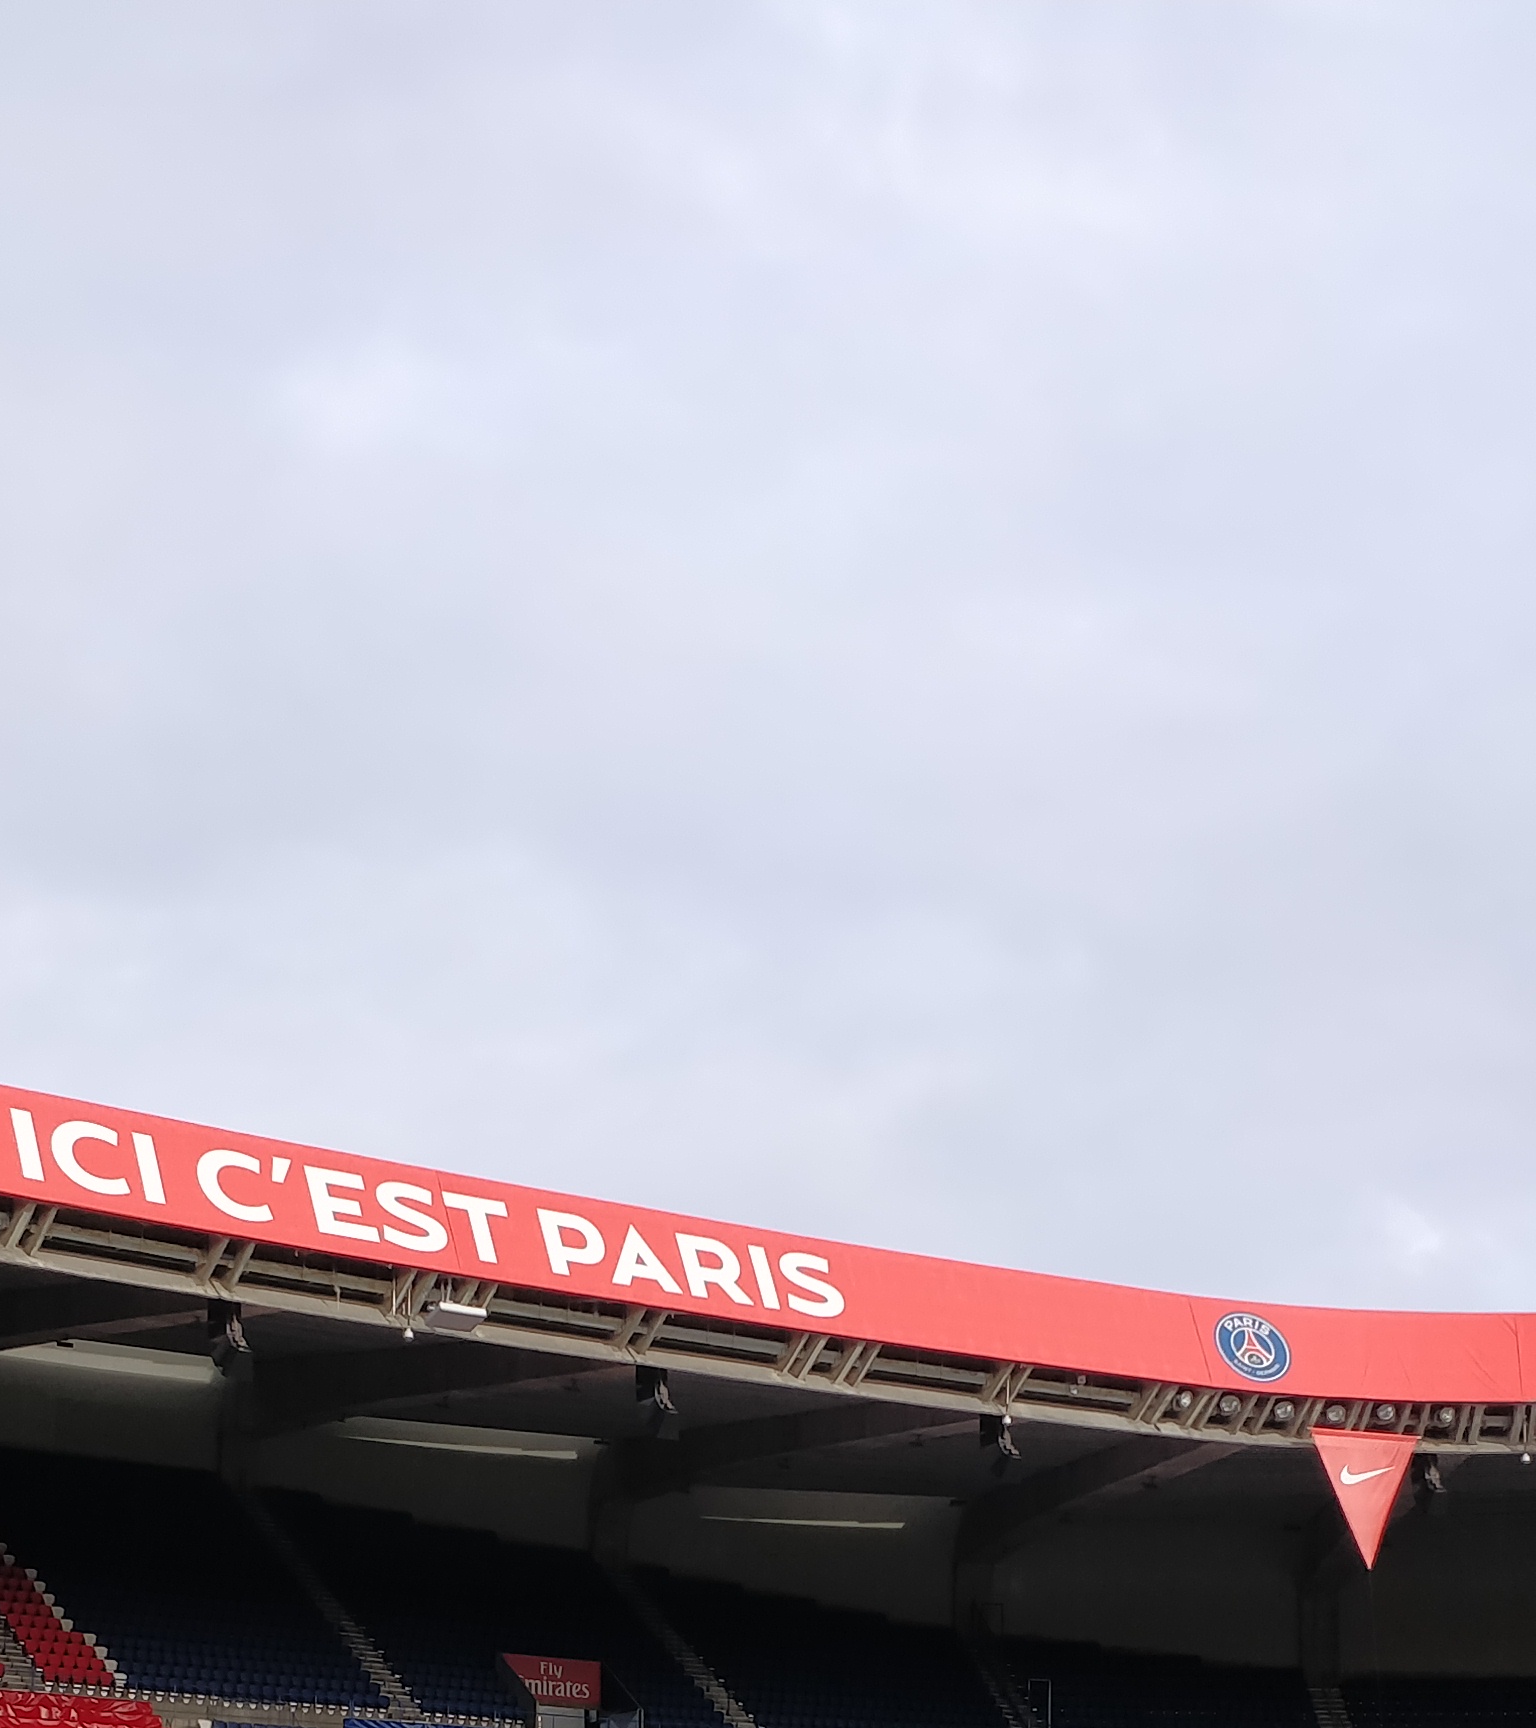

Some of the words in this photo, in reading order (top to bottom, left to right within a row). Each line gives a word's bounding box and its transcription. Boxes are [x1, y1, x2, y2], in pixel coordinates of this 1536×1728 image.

[9, 1107, 166, 1204] ICI
[196, 1148, 508, 1264] C'EST
[536, 1208, 845, 1318] PARIS
[1223, 1316, 1271, 1336] PARIS
[540, 1661, 563, 1678] Fly
[519, 1675, 590, 1699] mirates
